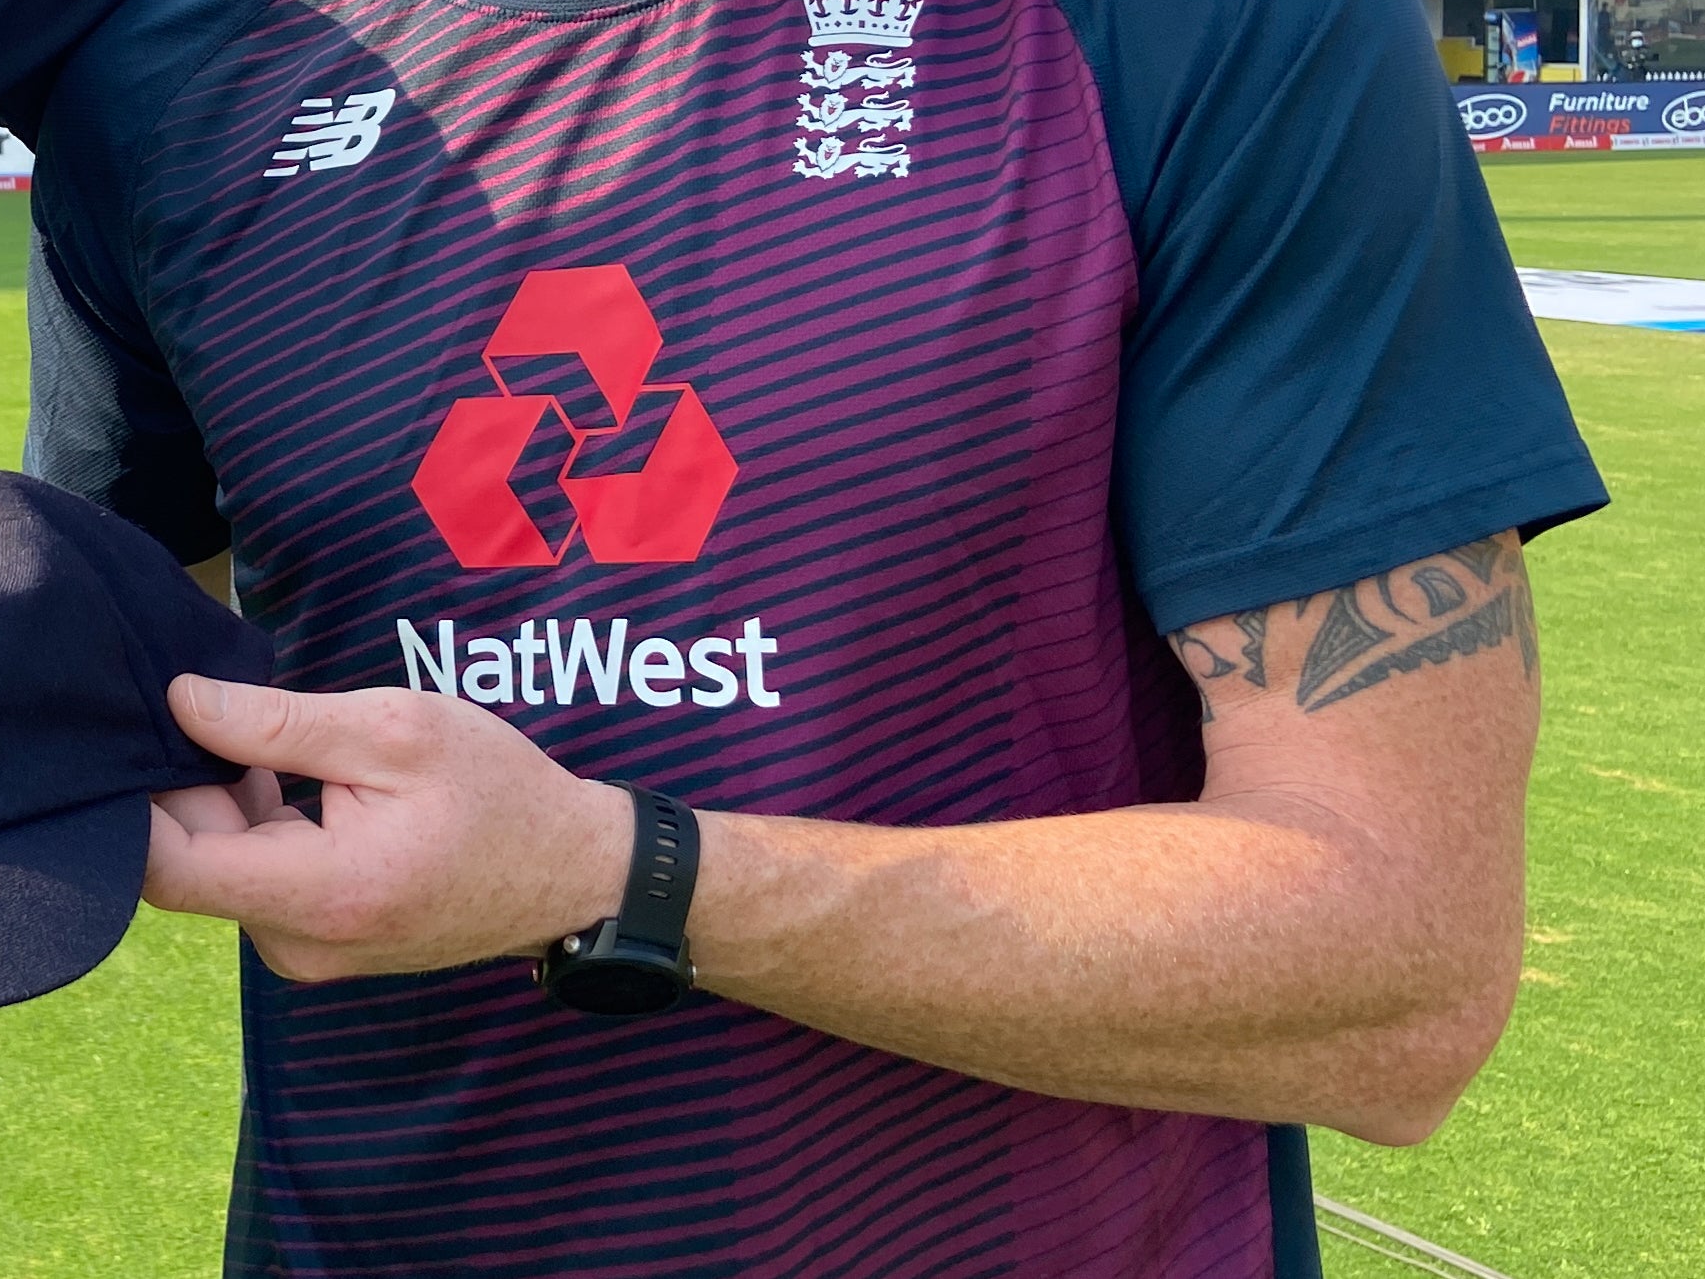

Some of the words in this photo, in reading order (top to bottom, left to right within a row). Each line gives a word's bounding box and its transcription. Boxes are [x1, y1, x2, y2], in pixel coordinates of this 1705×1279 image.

[1549, 92, 1650, 112] Furniture
[1549, 115, 1631, 134] Fittings
[1501, 137, 1535, 150] Amul
[1564, 135, 1598, 149] Amul
[397, 617, 780, 708] NatWest
